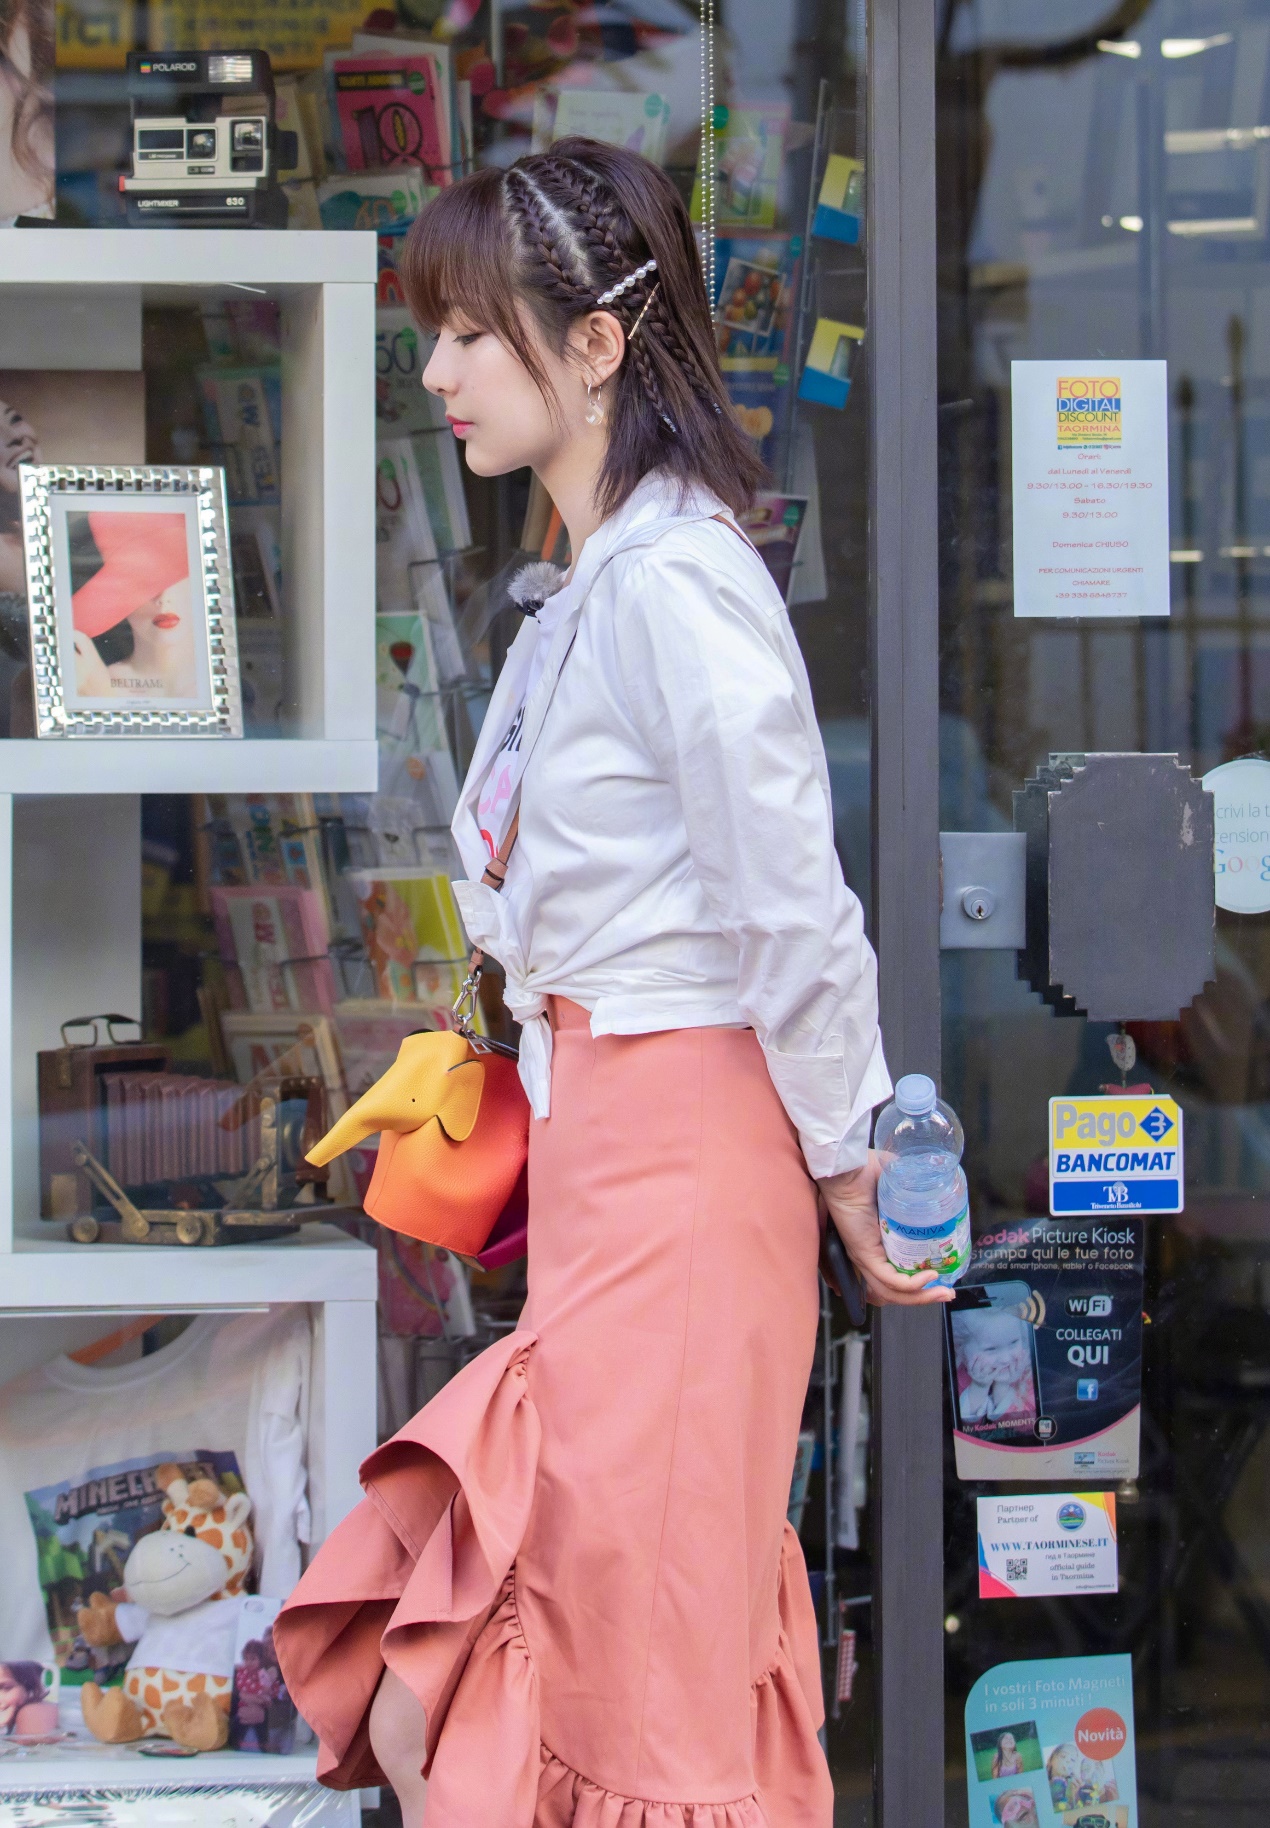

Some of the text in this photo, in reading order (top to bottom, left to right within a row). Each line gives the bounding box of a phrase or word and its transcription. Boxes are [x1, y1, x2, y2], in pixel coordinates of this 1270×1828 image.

[152, 62, 197, 72] POLAROID
[137, 197, 246, 208] LIGHTMIXER 630
[1058, 380, 1119, 398] FOTO
[1058, 398, 1119, 411] DIGITAL
[1058, 412, 1118, 422] DISCOUNT
[1027, 482, 1083, 490] 9.30/13.00
[1062, 511, 1118, 519] 9.30/13.00
[1215, 803, 1244, 819] crivi
[1248, 803, 1261, 818] la
[1056, 1104, 1137, 1147] Pago
[1056, 1152, 1176, 1173] BANCOMAT
[896, 1225, 946, 1236] MANIVA
[1032, 1227, 1088, 1244] Picture
[1092, 1227, 1136, 1244] Kiosk
[970, 1246, 1135, 1262] stampa qui le tue foto
[1095, 1262, 1134, 1270] Facebook
[1055, 1328, 1122, 1341] COLLEGATI
[1067, 1345, 1109, 1367] QUI
[996, 1504, 1035, 1513] Партнер
[996, 1514, 1039, 1524] Partner of
[990, 1537, 1109, 1552] WWW.TAORMINESE.IT
[1049, 1562, 1096, 1571] official guide
[984, 1675, 1126, 1696] I vostri Foto Magneti
[985, 1700, 998, 1713] in
[1001, 1697, 1025, 1712] soli
[1029, 1697, 1037, 1710] 3
[1041, 1693, 1085, 1709] minuti
[1077, 1727, 1124, 1743] Novità
